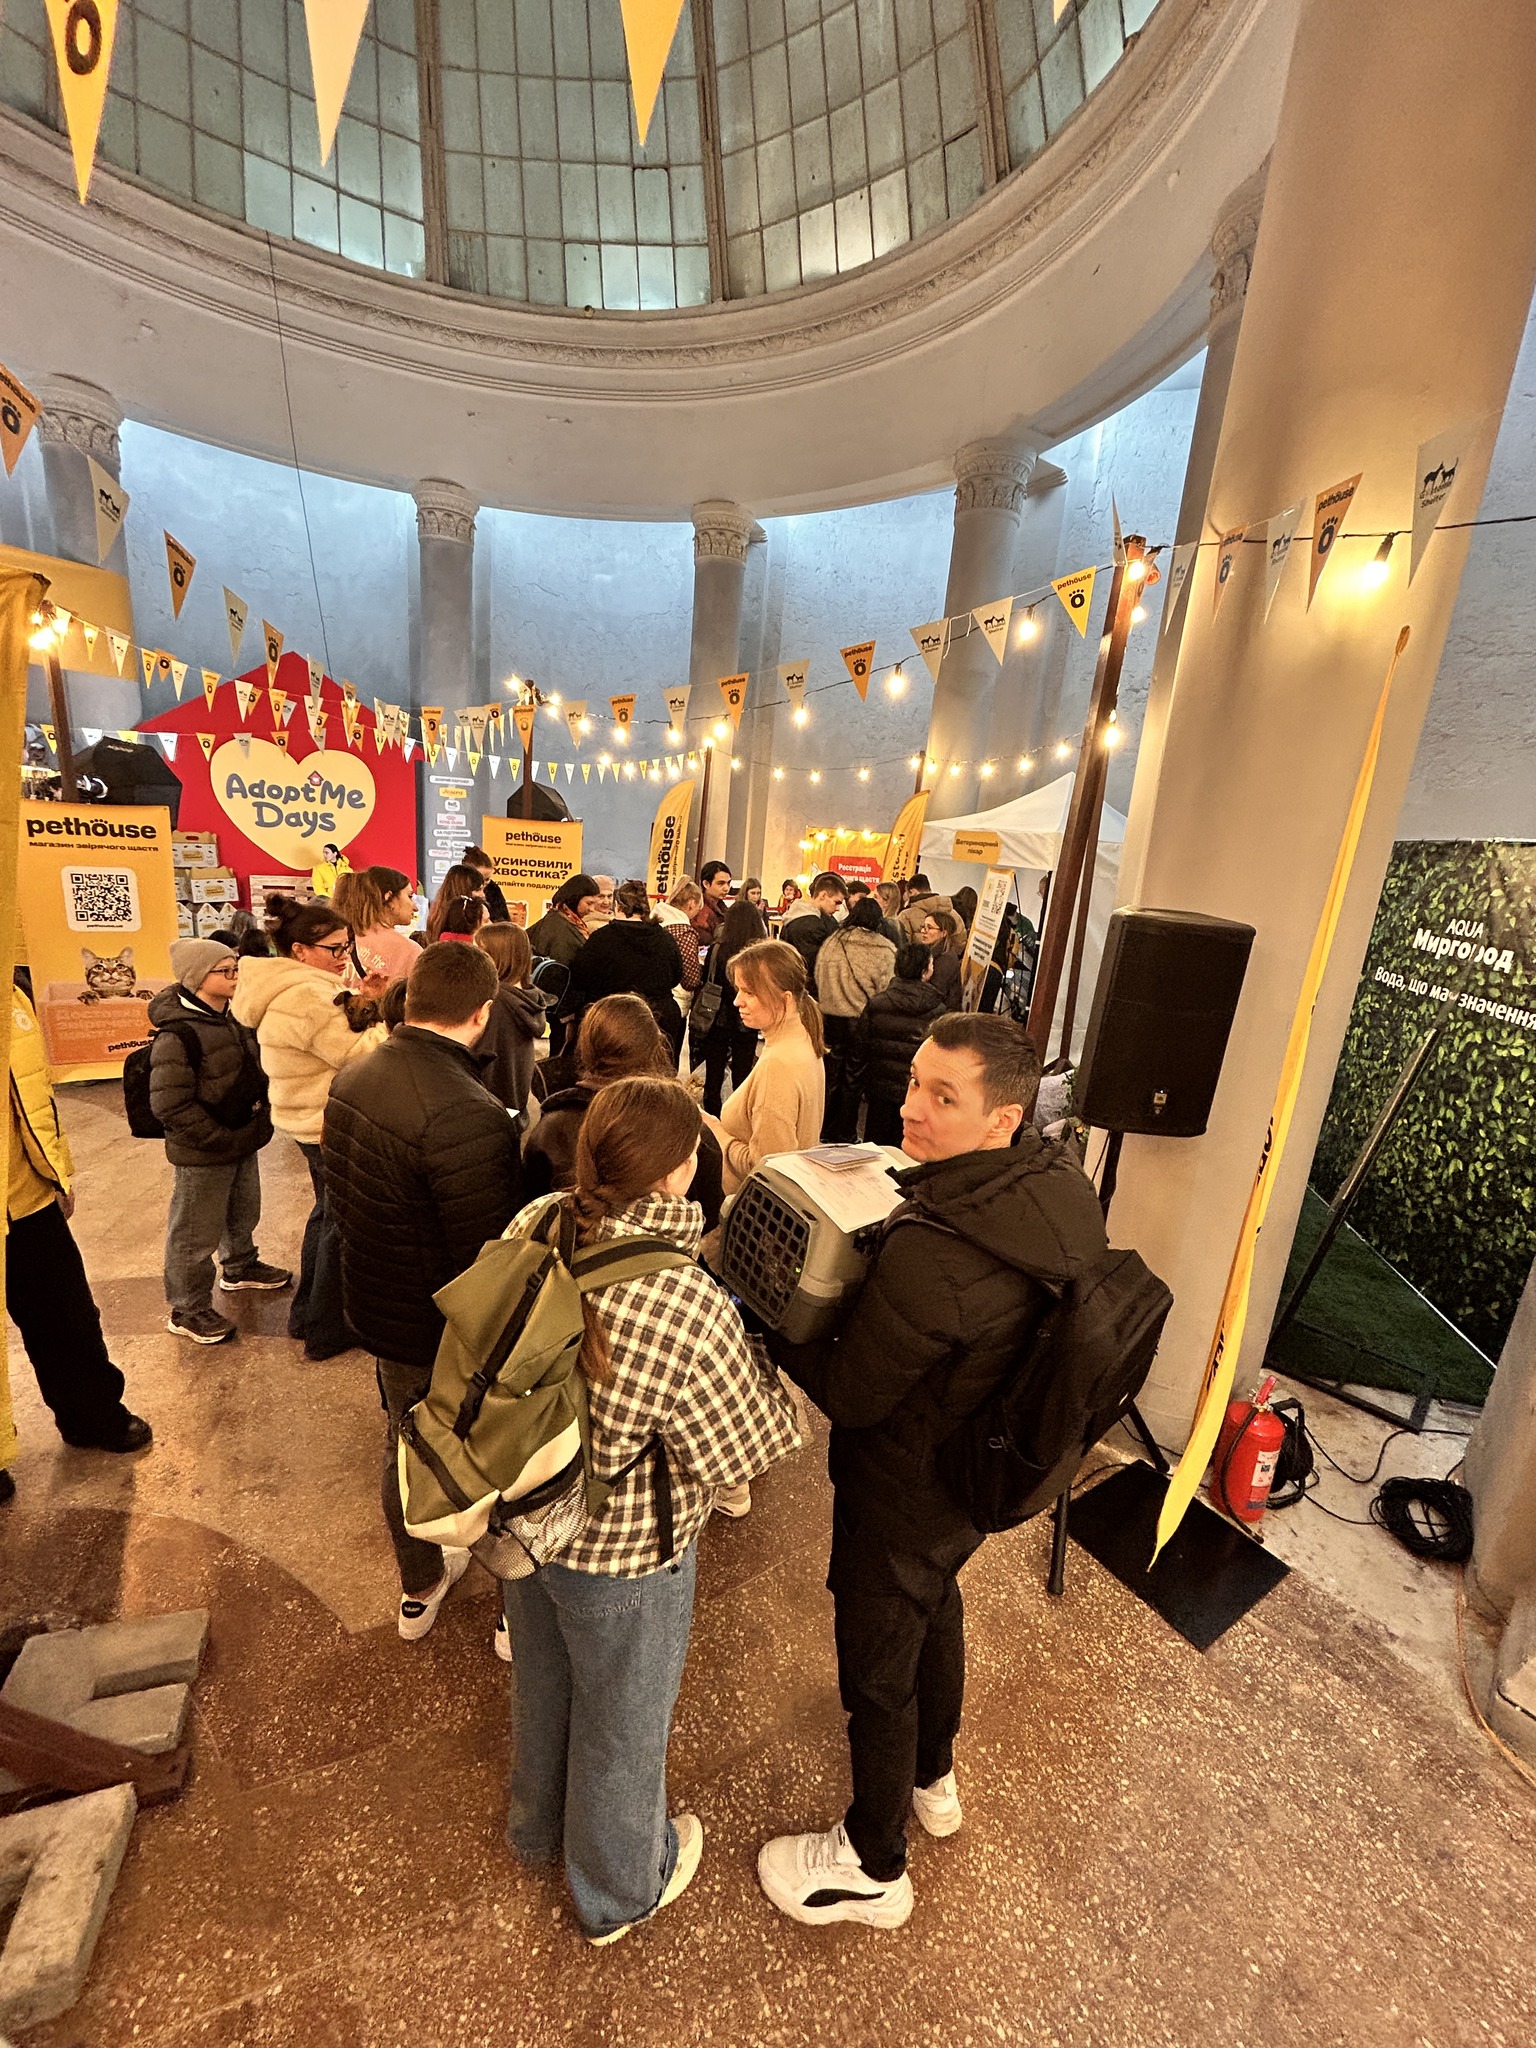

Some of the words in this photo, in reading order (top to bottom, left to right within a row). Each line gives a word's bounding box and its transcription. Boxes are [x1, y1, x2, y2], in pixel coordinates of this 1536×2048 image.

[226, 773, 316, 805] Adopt
[320, 780, 366, 810] Me
[252, 801, 336, 838] Days
[492, 856, 573, 870] усиновили
[492, 867, 569, 880] хвостика?
[1445, 918, 1484, 938] AQUA
[1374, 966, 1406, 991] Вода,
[1408, 978, 1428, 995] що
